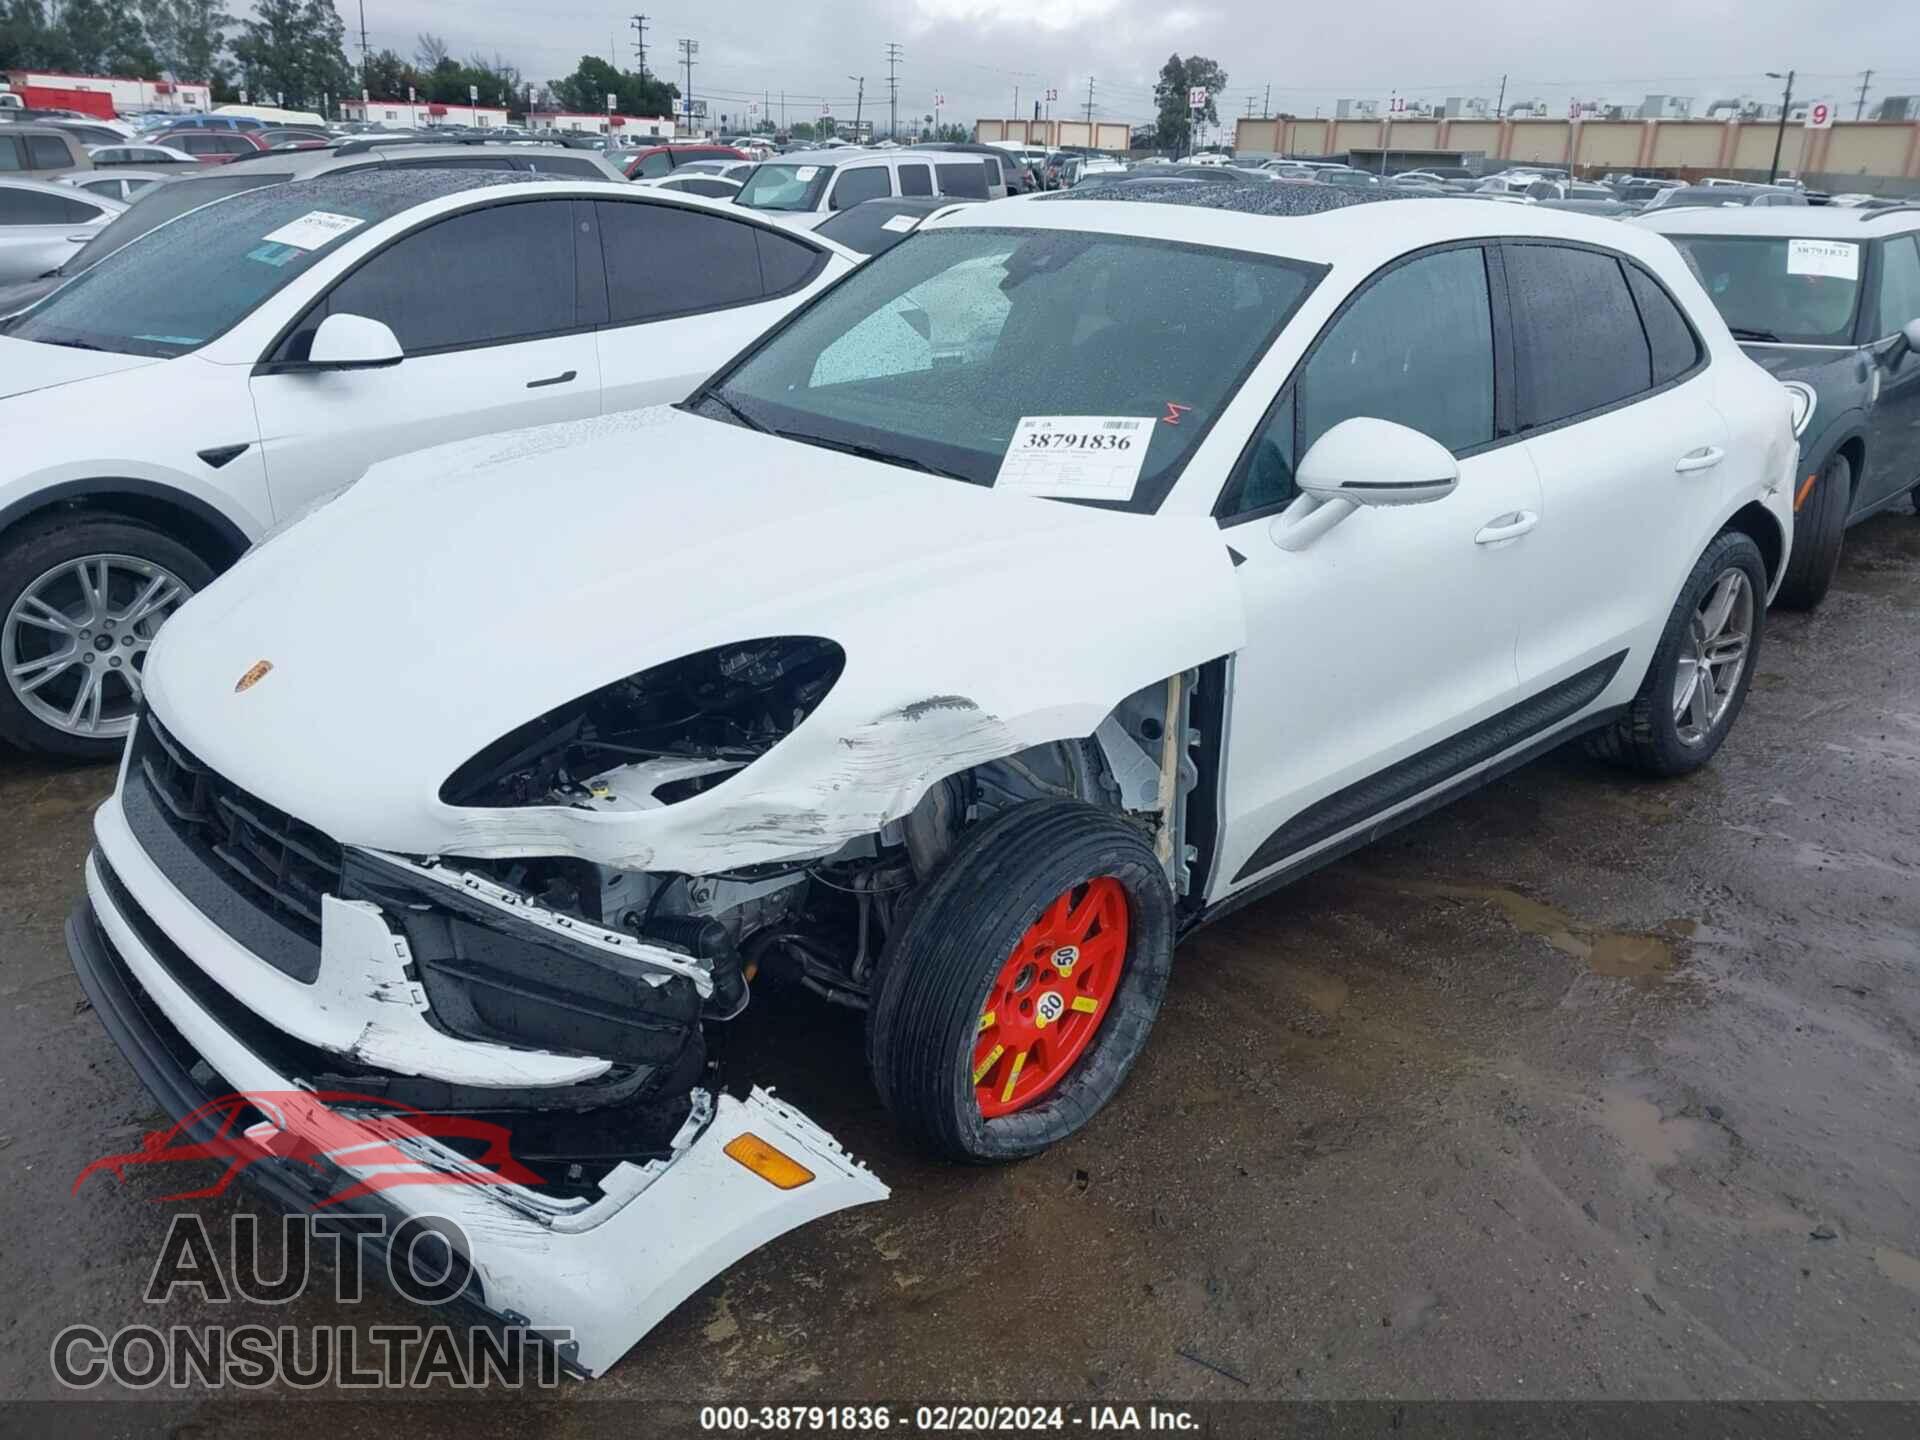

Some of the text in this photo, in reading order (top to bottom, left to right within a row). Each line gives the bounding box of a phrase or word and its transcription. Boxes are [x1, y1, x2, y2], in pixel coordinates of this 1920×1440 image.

[1046, 90, 1058, 101] 13
[1191, 91, 1206, 104] 12
[1390, 98, 1404, 112] 11
[1814, 105, 1827, 125] 9
[1023, 433, 1132, 450] 38791836
[1057, 948, 1074, 965] 50
[1041, 995, 1061, 1019] 80
